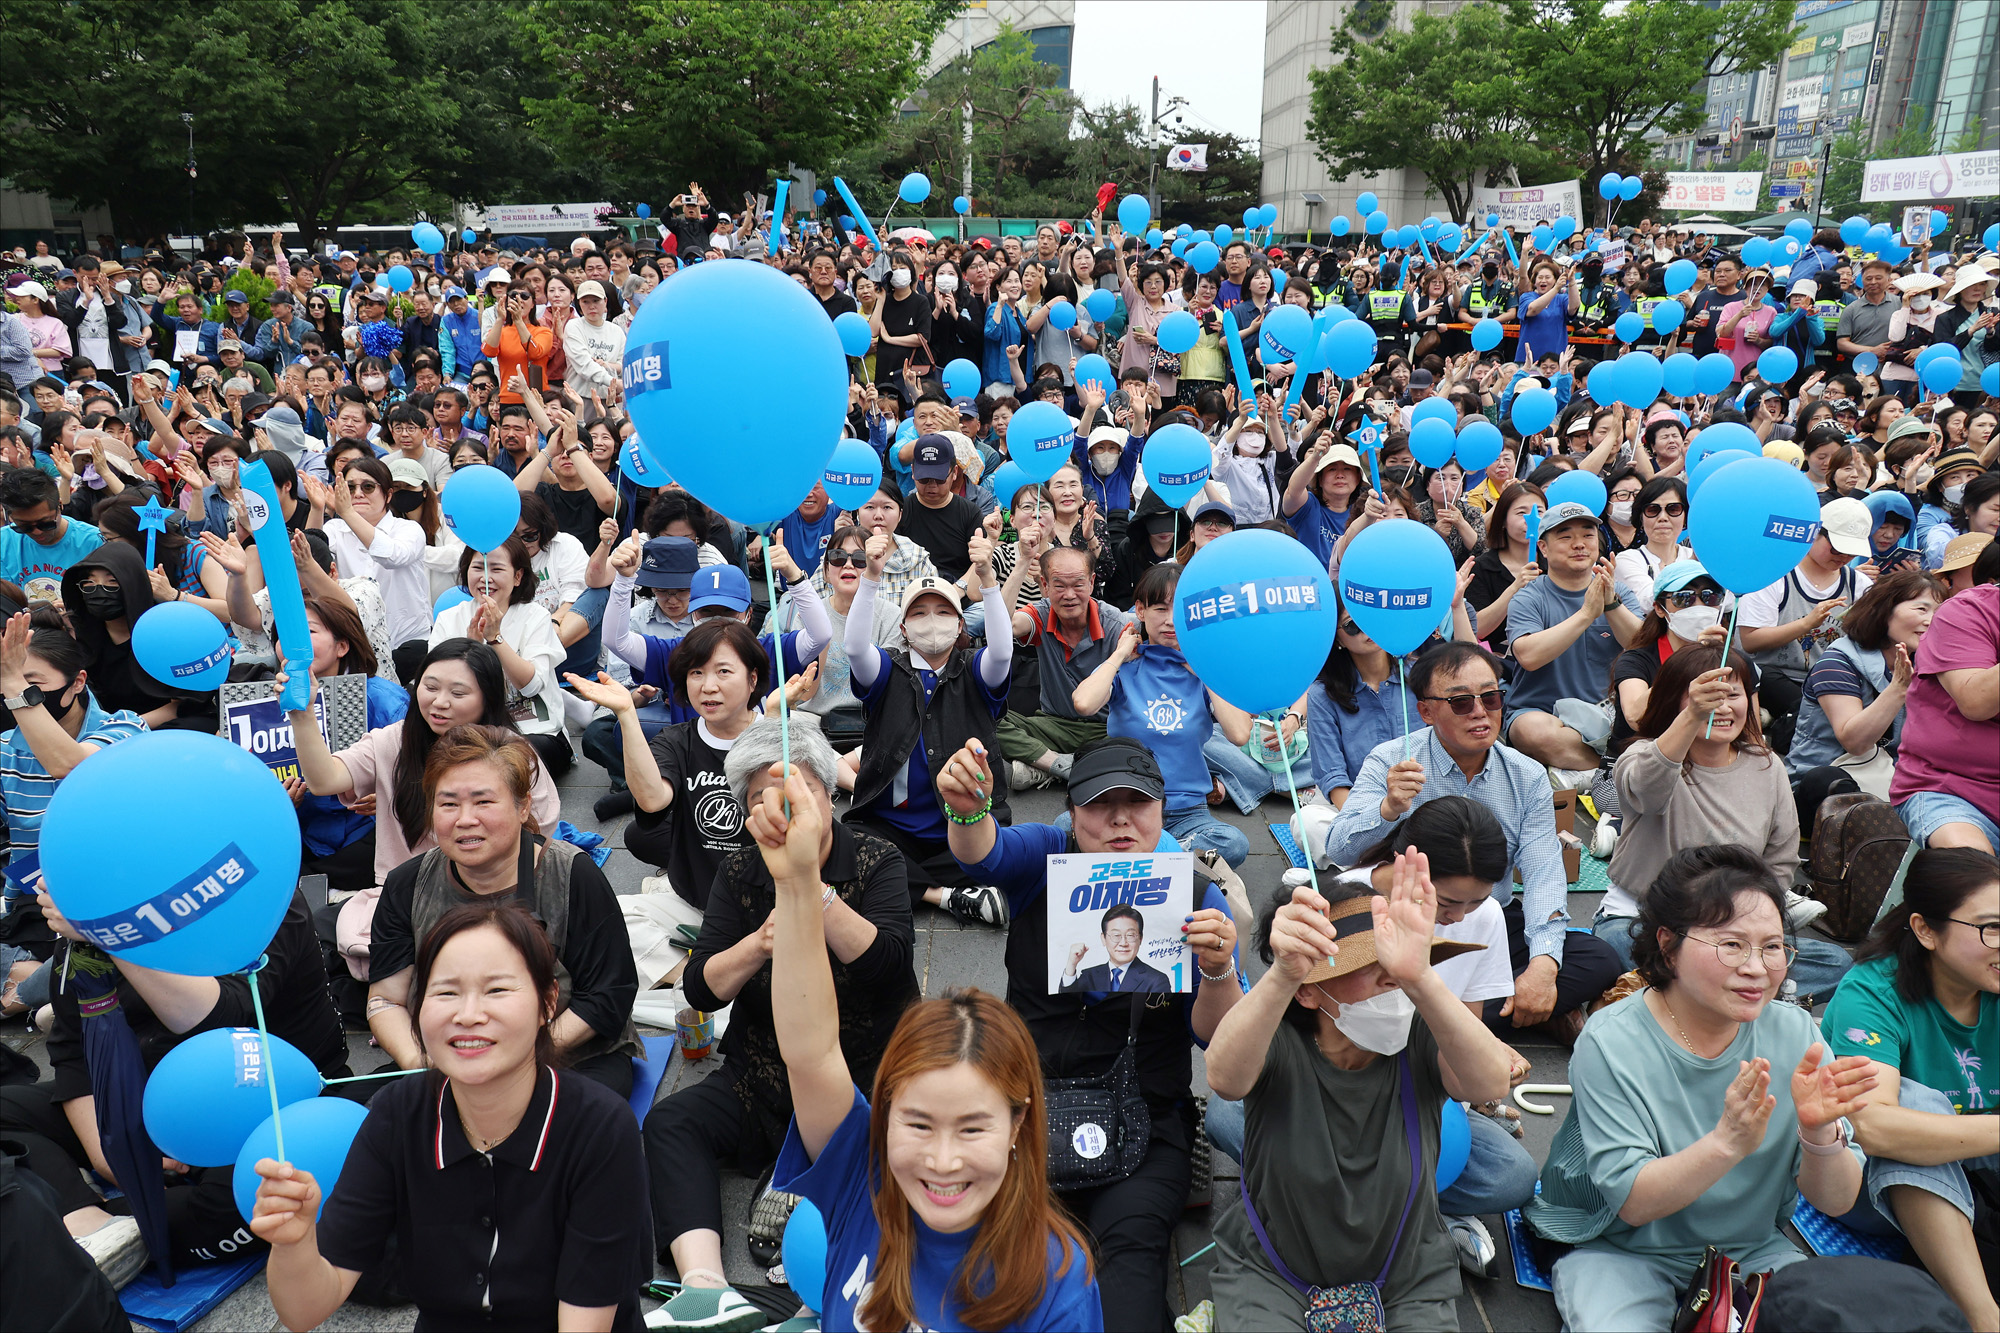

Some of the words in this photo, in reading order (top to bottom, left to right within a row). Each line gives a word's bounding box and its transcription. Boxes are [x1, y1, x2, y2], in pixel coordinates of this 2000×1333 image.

[1779, 108, 1798, 120] 우회전시
[1778, 123, 1796, 135] 신호준수
[624, 355, 662, 389] 이재명
[1038, 439, 1058, 450] 지금은
[1059, 435, 1064, 446] 1
[826, 472, 843, 483] 지금은
[845, 474, 851, 485] 1
[854, 476, 873, 485] 이재명
[1161, 476, 1182, 485] 지금은
[1184, 474, 1190, 484] 1
[1770, 521, 1806, 539] 지금은
[711, 571, 720, 588] 1
[1188, 594, 1236, 621] 지금은
[1240, 583, 1259, 613] 1
[1264, 585, 1317, 607] 이재명
[1347, 586, 1375, 604] 지금은
[1378, 590, 1388, 608] 1
[1392, 594, 1428, 607] 이재명
[175, 663, 204, 676] 지금은
[204, 656, 215, 668] 1
[213, 642, 230, 661] 이재명
[1088, 859, 1154, 883] 교육도
[136, 903, 177, 935] 1
[169, 858, 245, 917] 이재명
[1069, 876, 1172, 913] 이재명
[1171, 962, 1183, 993] 1
[242, 1042, 260, 1081] 지금은
[1076, 1134, 1087, 1152] 1
[1087, 1126, 1101, 1155] 이재명
